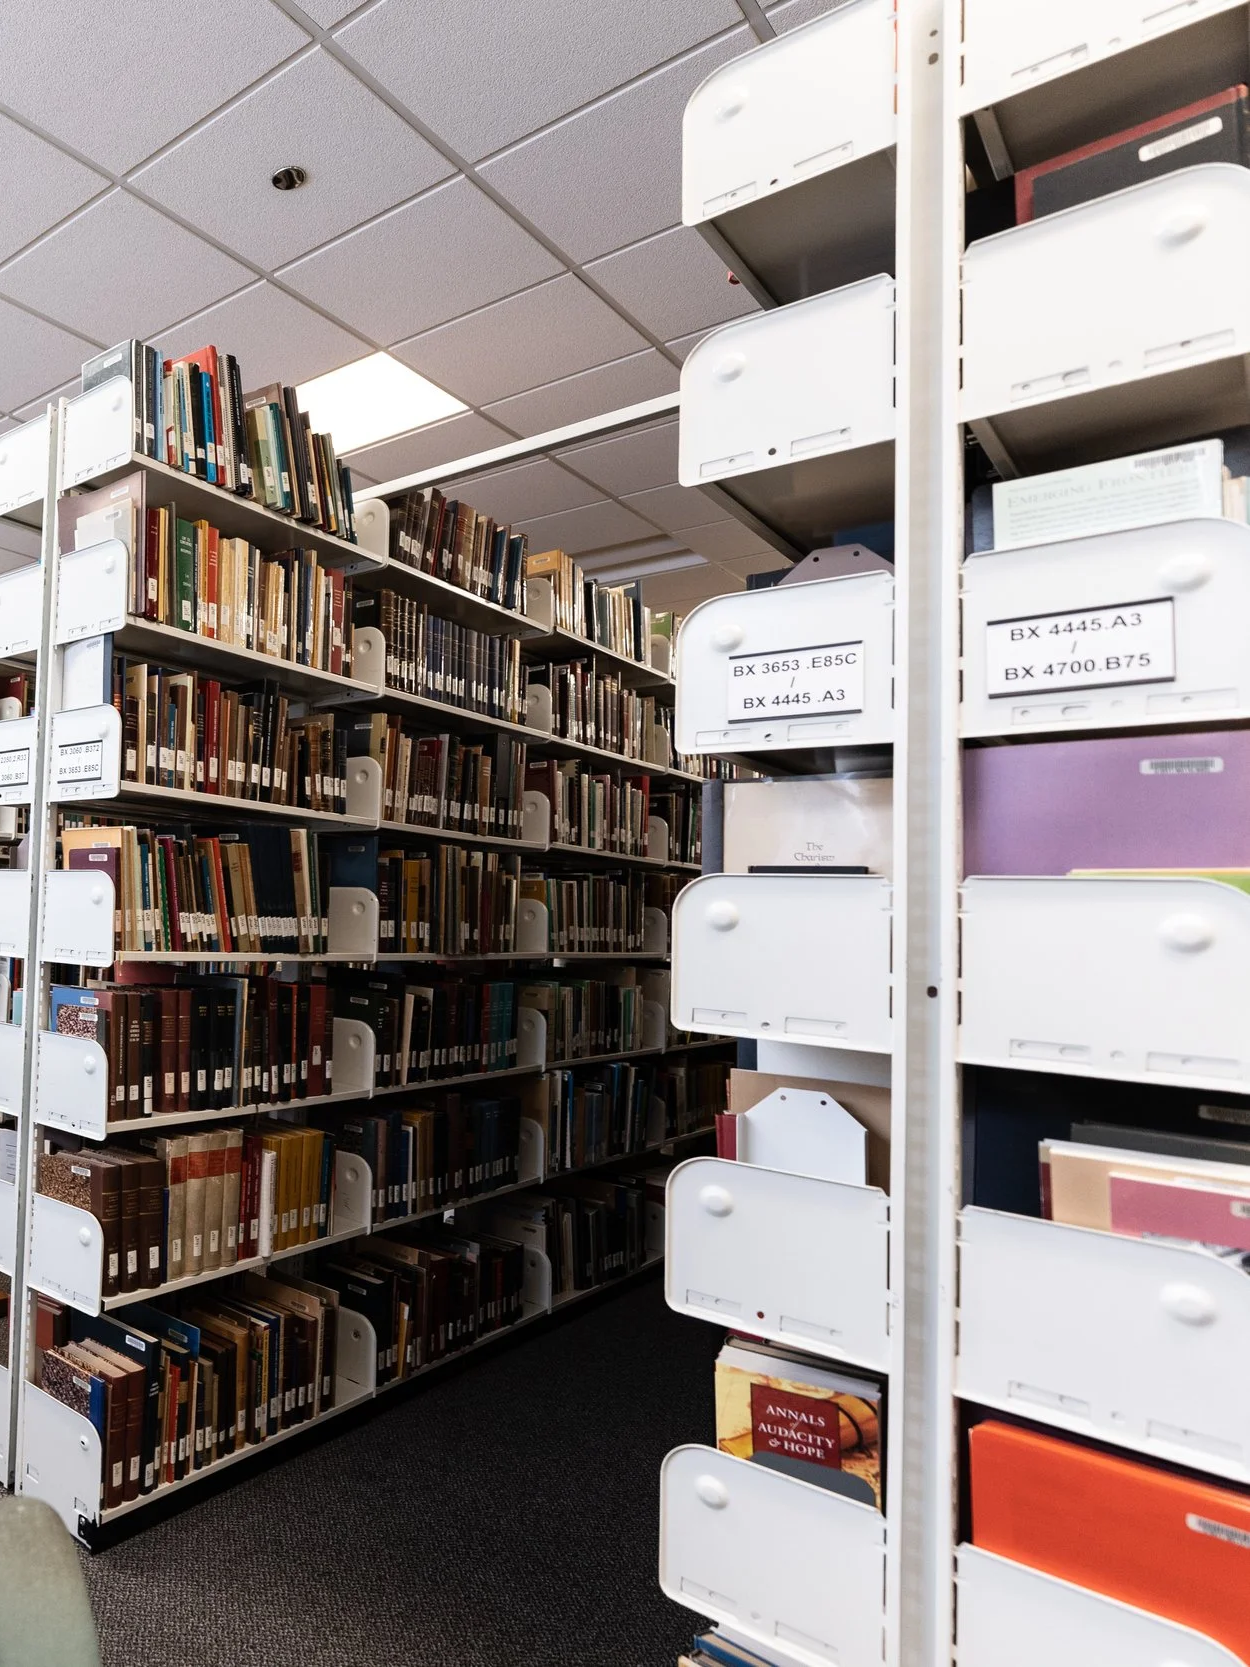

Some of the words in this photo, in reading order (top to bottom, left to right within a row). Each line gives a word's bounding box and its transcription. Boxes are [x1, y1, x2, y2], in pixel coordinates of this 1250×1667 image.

[1010, 626, 1041, 641] BX
[1048, 612, 1142, 636] 4445.A3
[733, 664, 756, 677] BX
[761, 659, 800, 674] 3653
[806, 652, 857, 669] .E85C
[1005, 665, 1035, 681] BX
[1042, 652, 1151, 677] 4700.B75
[743, 696, 766, 709] BX
[771, 692, 811, 706] 4445
[817, 689, 845, 703] .A3
[806, 842, 824, 851] The
[766, 1404, 826, 1427] ANNALS
[758, 1422, 835, 1449] AUDACITY
[783, 1440, 825, 1460] HOPE
